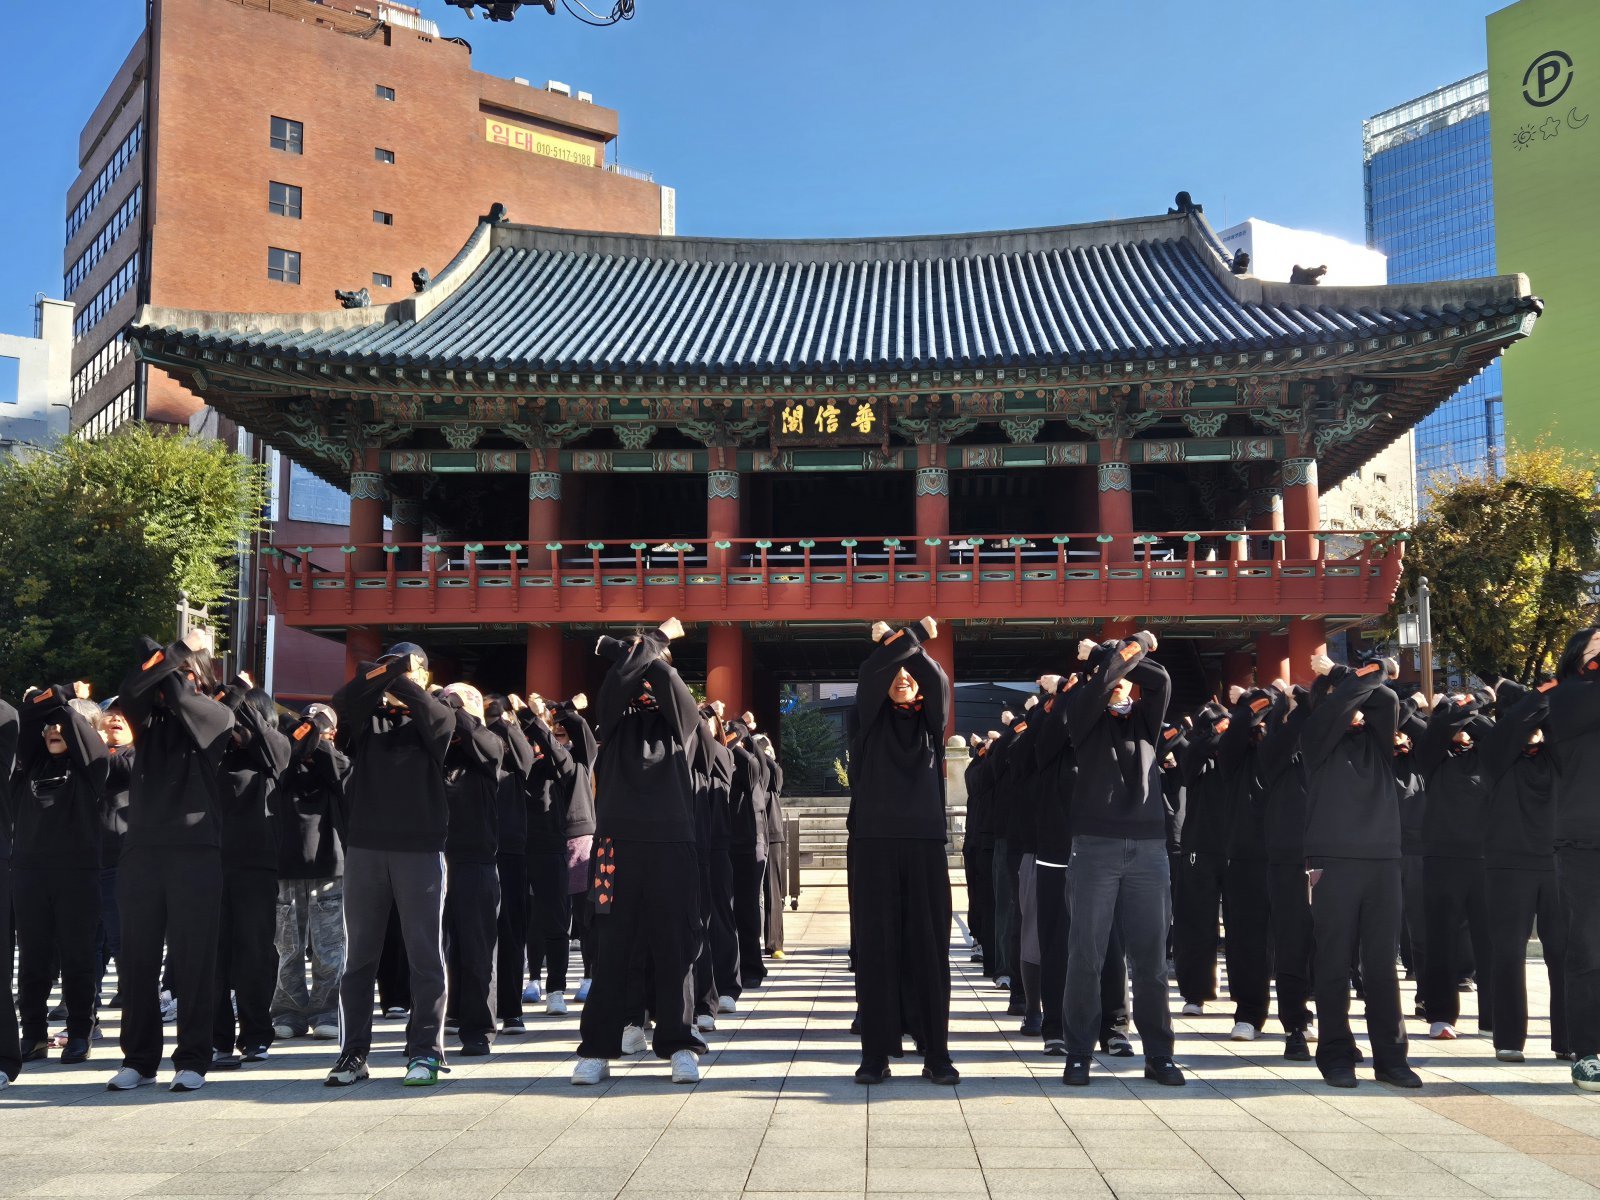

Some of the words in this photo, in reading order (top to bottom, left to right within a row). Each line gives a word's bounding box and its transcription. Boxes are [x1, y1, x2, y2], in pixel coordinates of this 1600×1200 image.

[1537, 60, 1561, 98] P
[492, 124, 533, 153] 임대
[536, 141, 591, 166] 010-5117-9188
